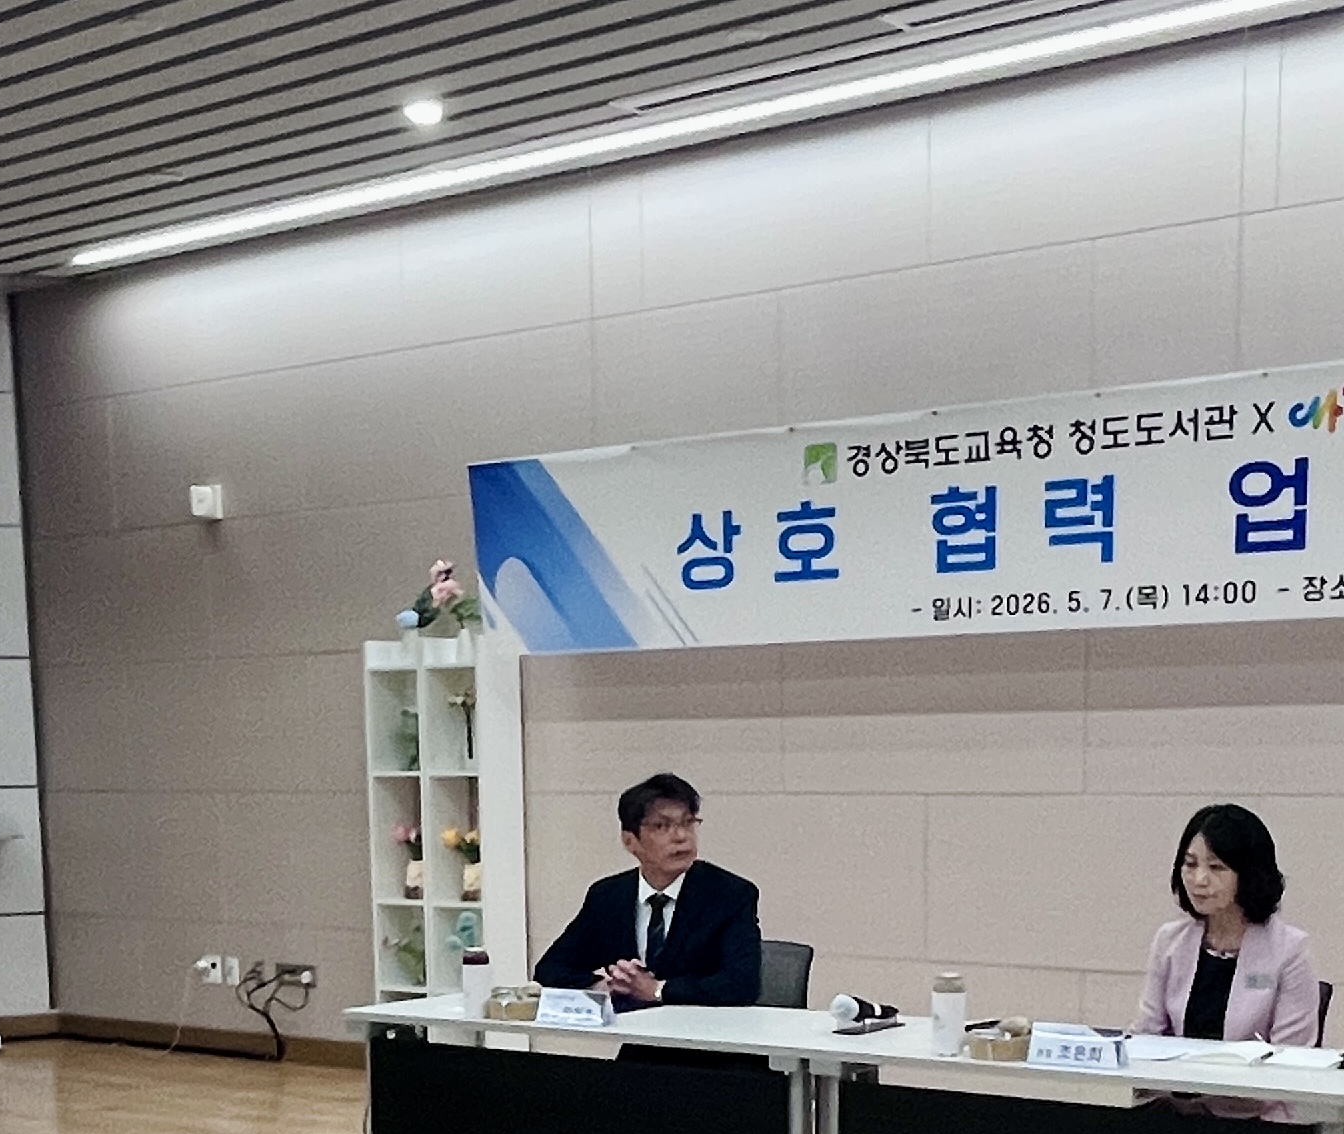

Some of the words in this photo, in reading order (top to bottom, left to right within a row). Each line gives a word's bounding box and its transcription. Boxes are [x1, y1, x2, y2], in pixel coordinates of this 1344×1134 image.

[846, 424, 1054, 478] 경상북도교육청
[1068, 404, 1239, 456] 청도도서관
[1251, 400, 1277, 436] X
[675, 500, 841, 592] 상호
[930, 474, 1116, 574] 협력
[931, 597, 982, 622] 일시:
[990, 592, 1058, 617] 2026.
[1067, 591, 1090, 614] 5.
[1099, 584, 1170, 612] 7.(목)
[1182, 580, 1258, 607] 14:00
